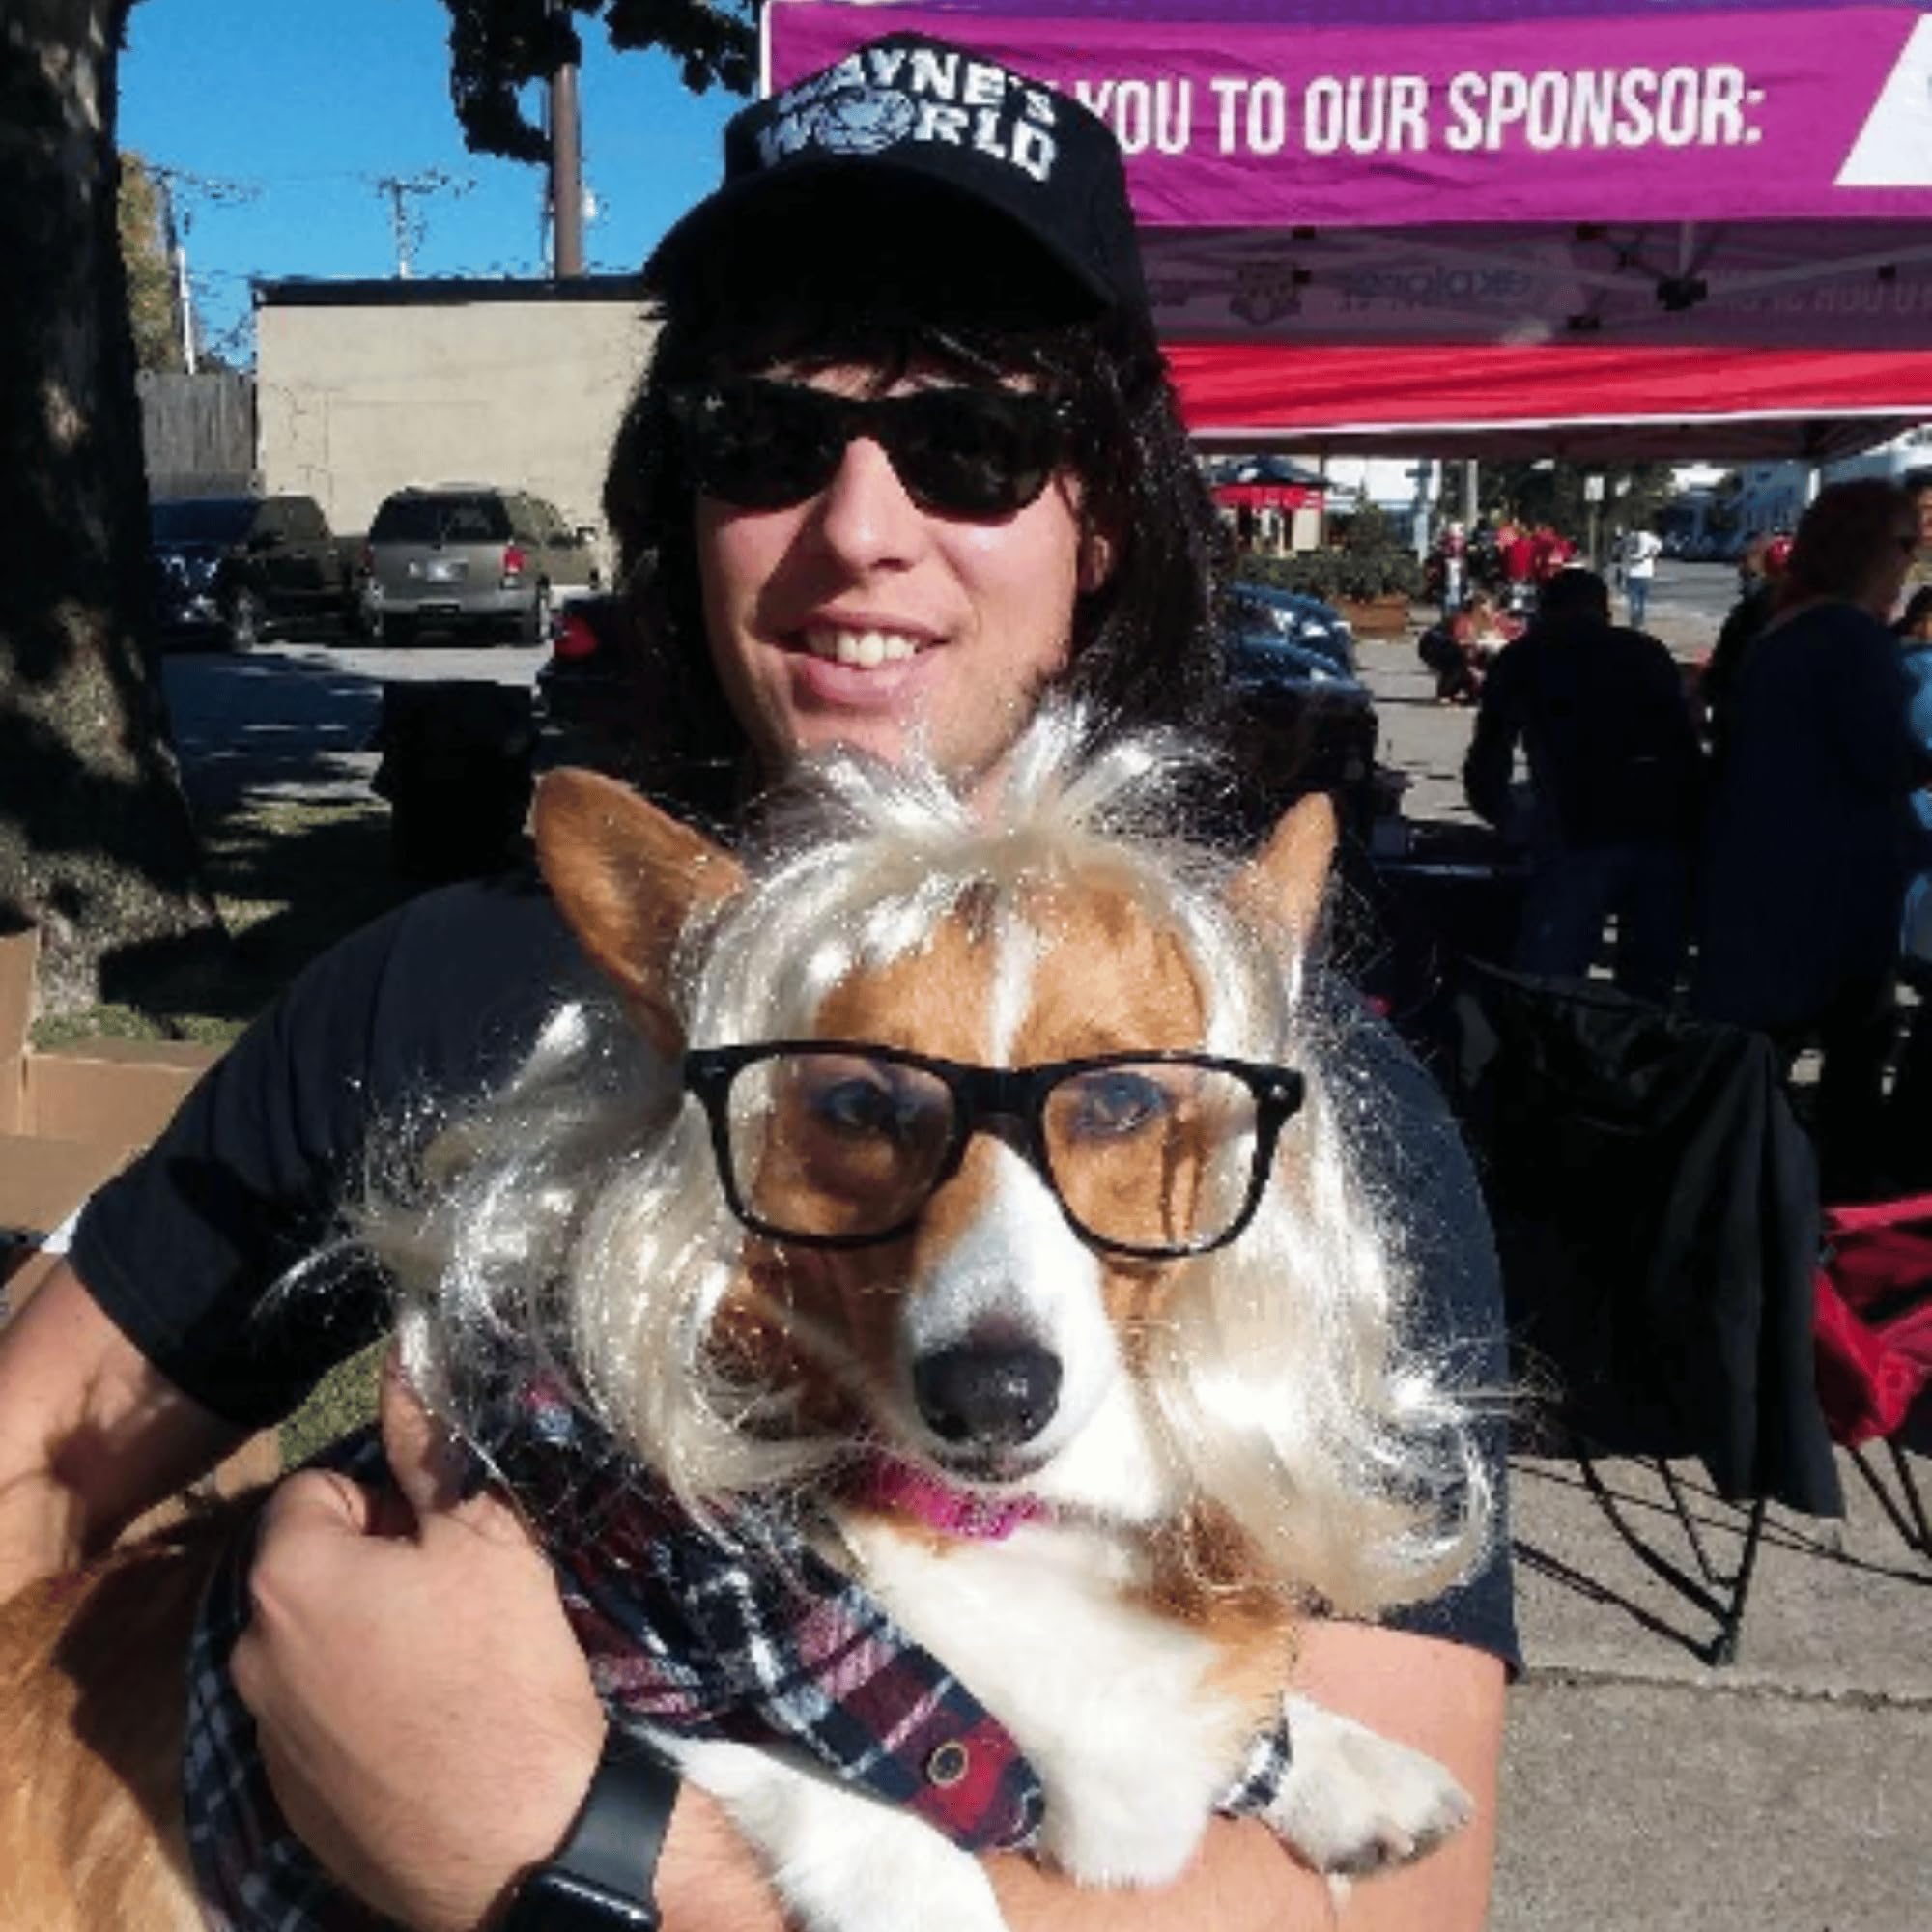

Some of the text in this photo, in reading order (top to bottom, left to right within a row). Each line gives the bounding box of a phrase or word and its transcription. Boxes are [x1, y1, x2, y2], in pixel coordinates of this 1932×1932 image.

[1075, 67, 1766, 156] YOU TO OUR SPONSOR:
